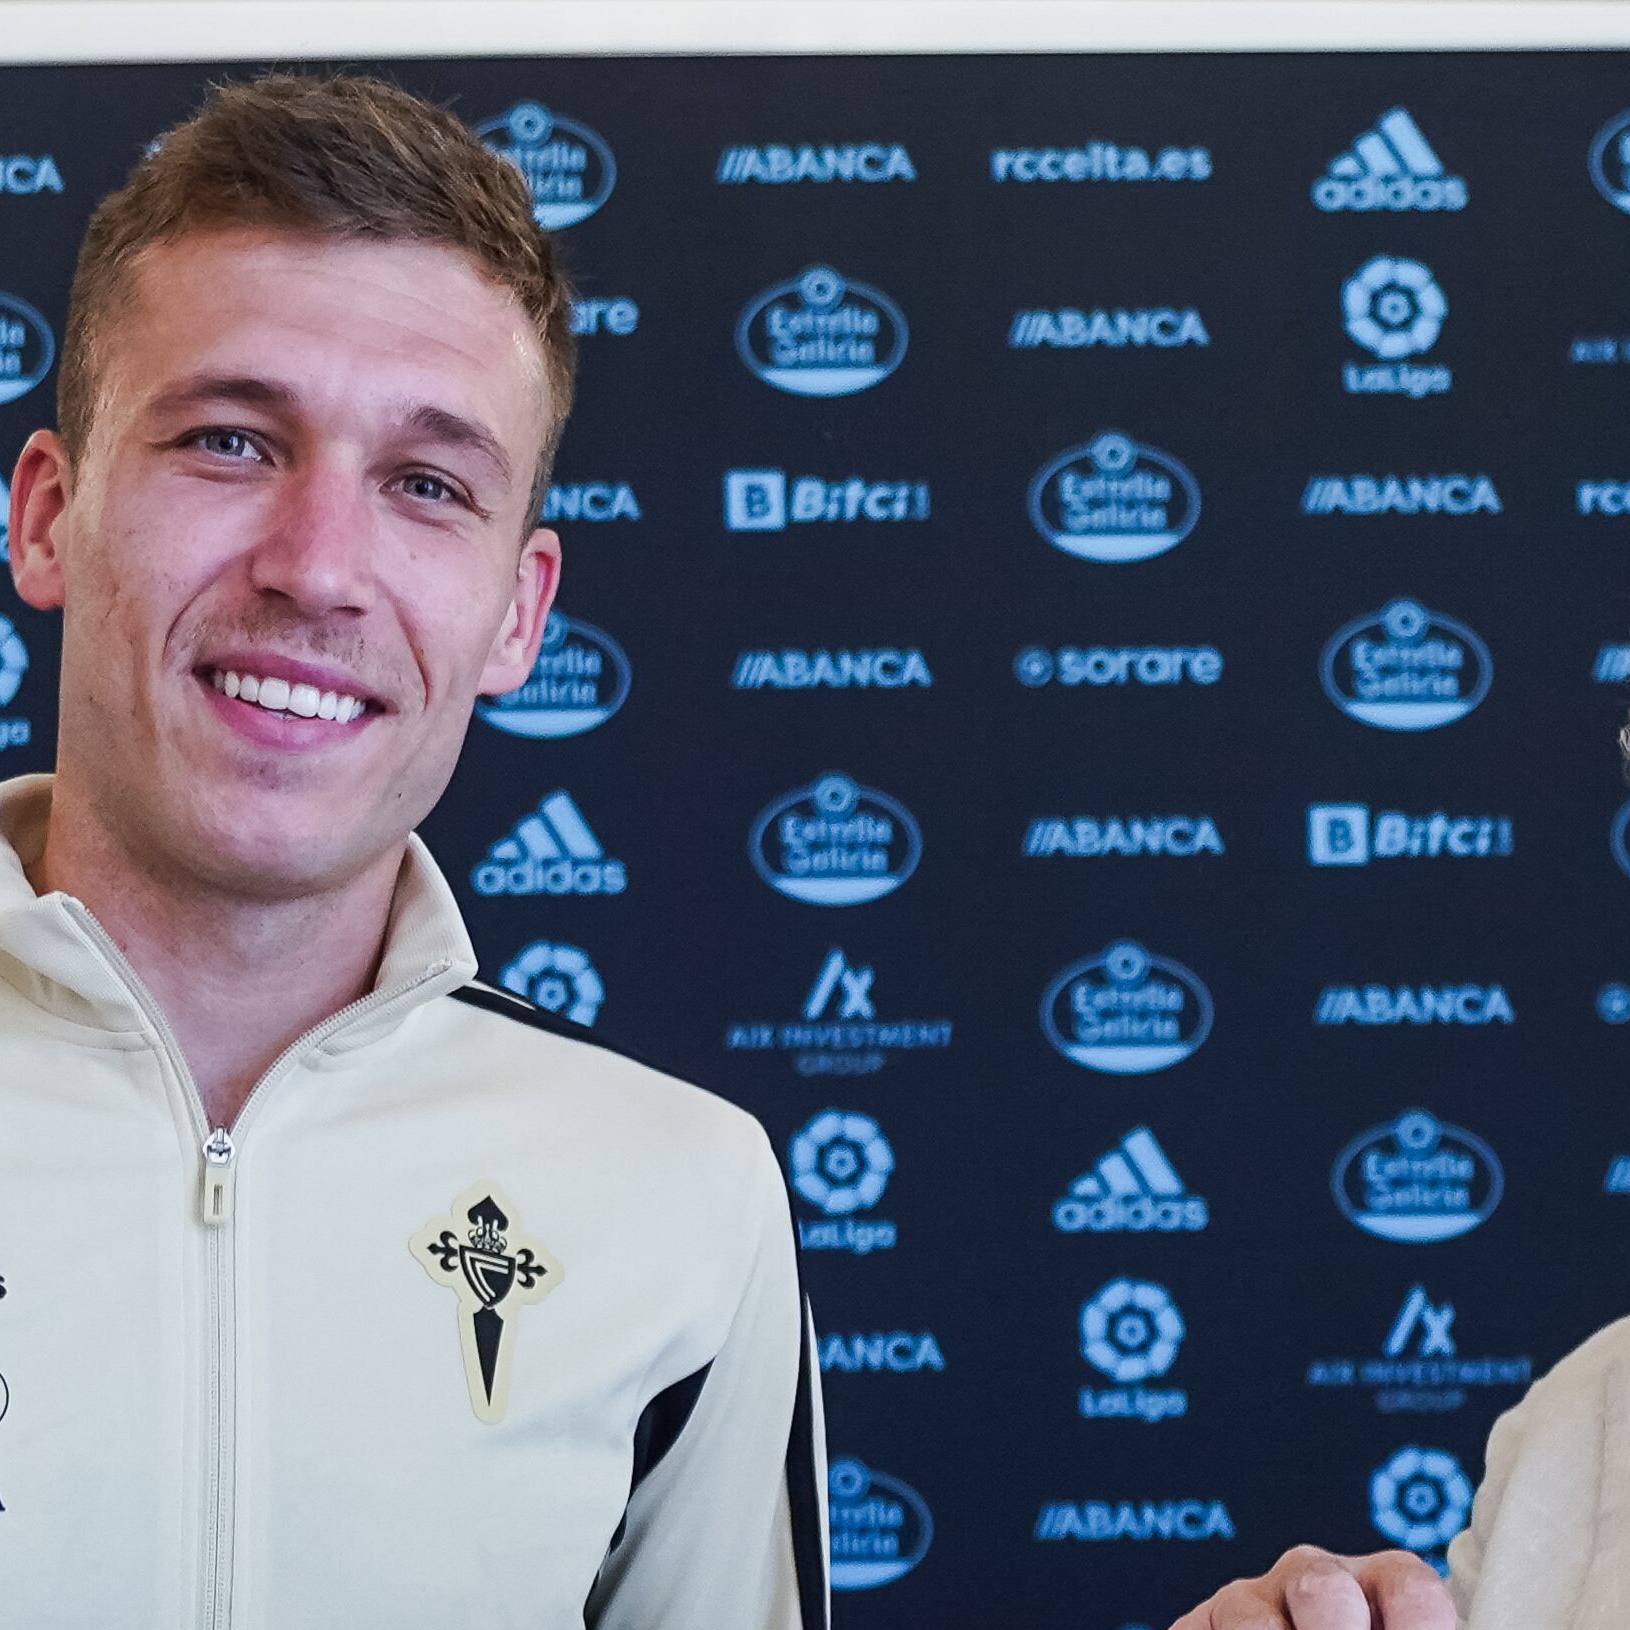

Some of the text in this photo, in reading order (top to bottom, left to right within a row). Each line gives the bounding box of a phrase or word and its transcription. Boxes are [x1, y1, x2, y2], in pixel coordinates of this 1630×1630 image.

[1312, 174, 1466, 210] adidas
[471, 858, 627, 895] adidas
[1052, 1195, 1208, 1232] adidas
